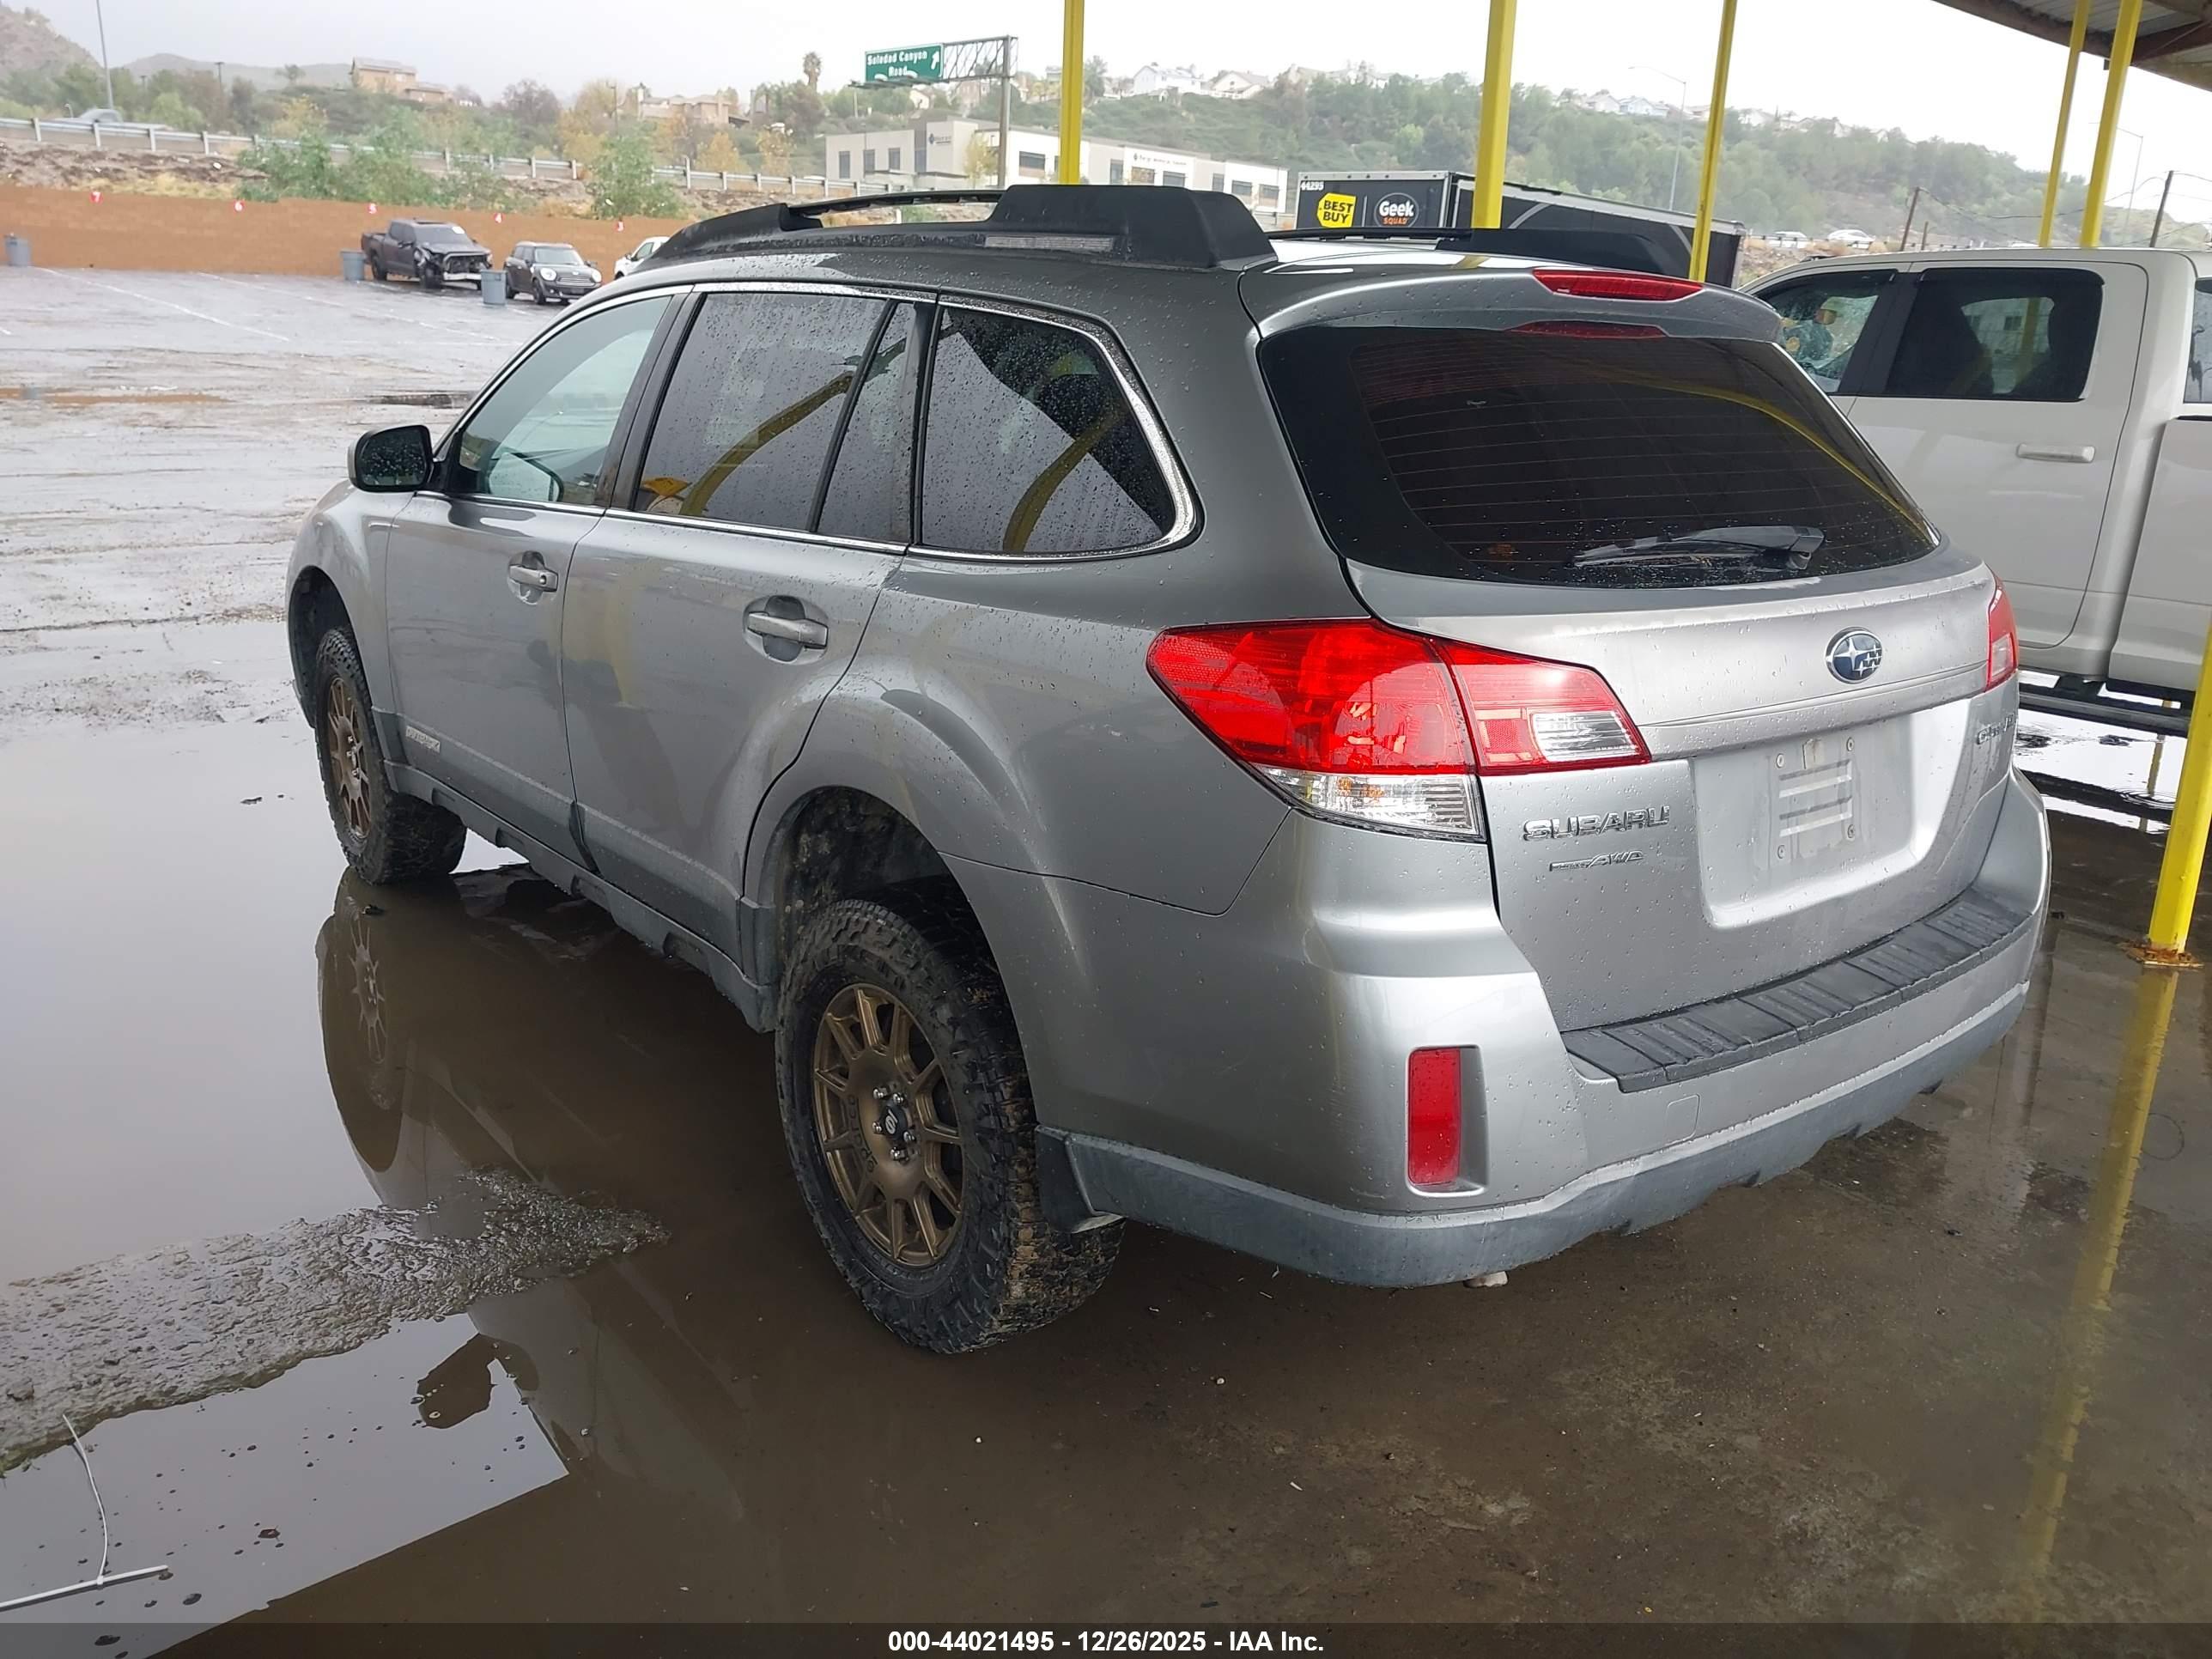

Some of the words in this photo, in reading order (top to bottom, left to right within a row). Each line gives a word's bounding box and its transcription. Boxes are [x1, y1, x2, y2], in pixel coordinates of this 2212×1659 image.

[899, 51, 927, 64] Canyon
[1323, 200, 1353, 212] BEST
[1379, 199, 1414, 217] Geek
[1322, 211, 1349, 224] BUY
[1383, 217, 1408, 226] SQUAD
[1522, 805, 1670, 842] SUBARU
[1587, 850, 1645, 867] AWD
